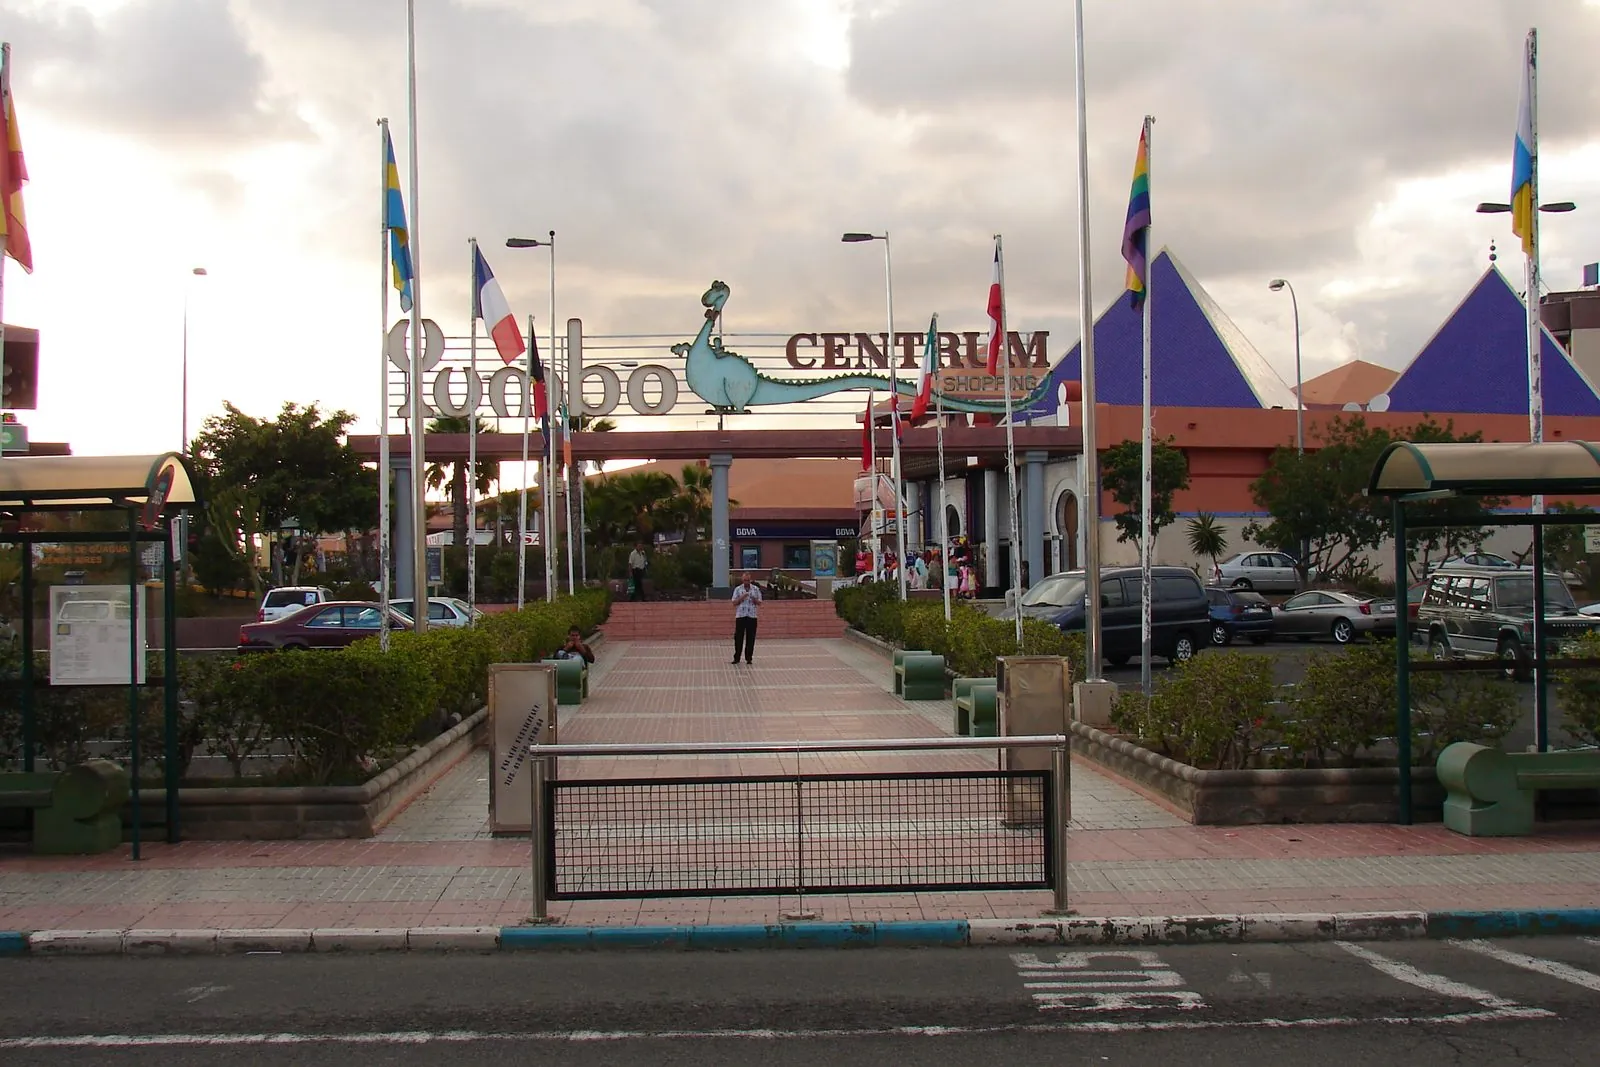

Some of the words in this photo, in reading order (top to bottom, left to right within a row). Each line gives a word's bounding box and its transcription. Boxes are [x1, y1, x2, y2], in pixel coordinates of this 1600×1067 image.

[785, 331, 1051, 370] CENTRUM
[736, 527, 757, 536] BBVA
[835, 528, 856, 536] BBVA
